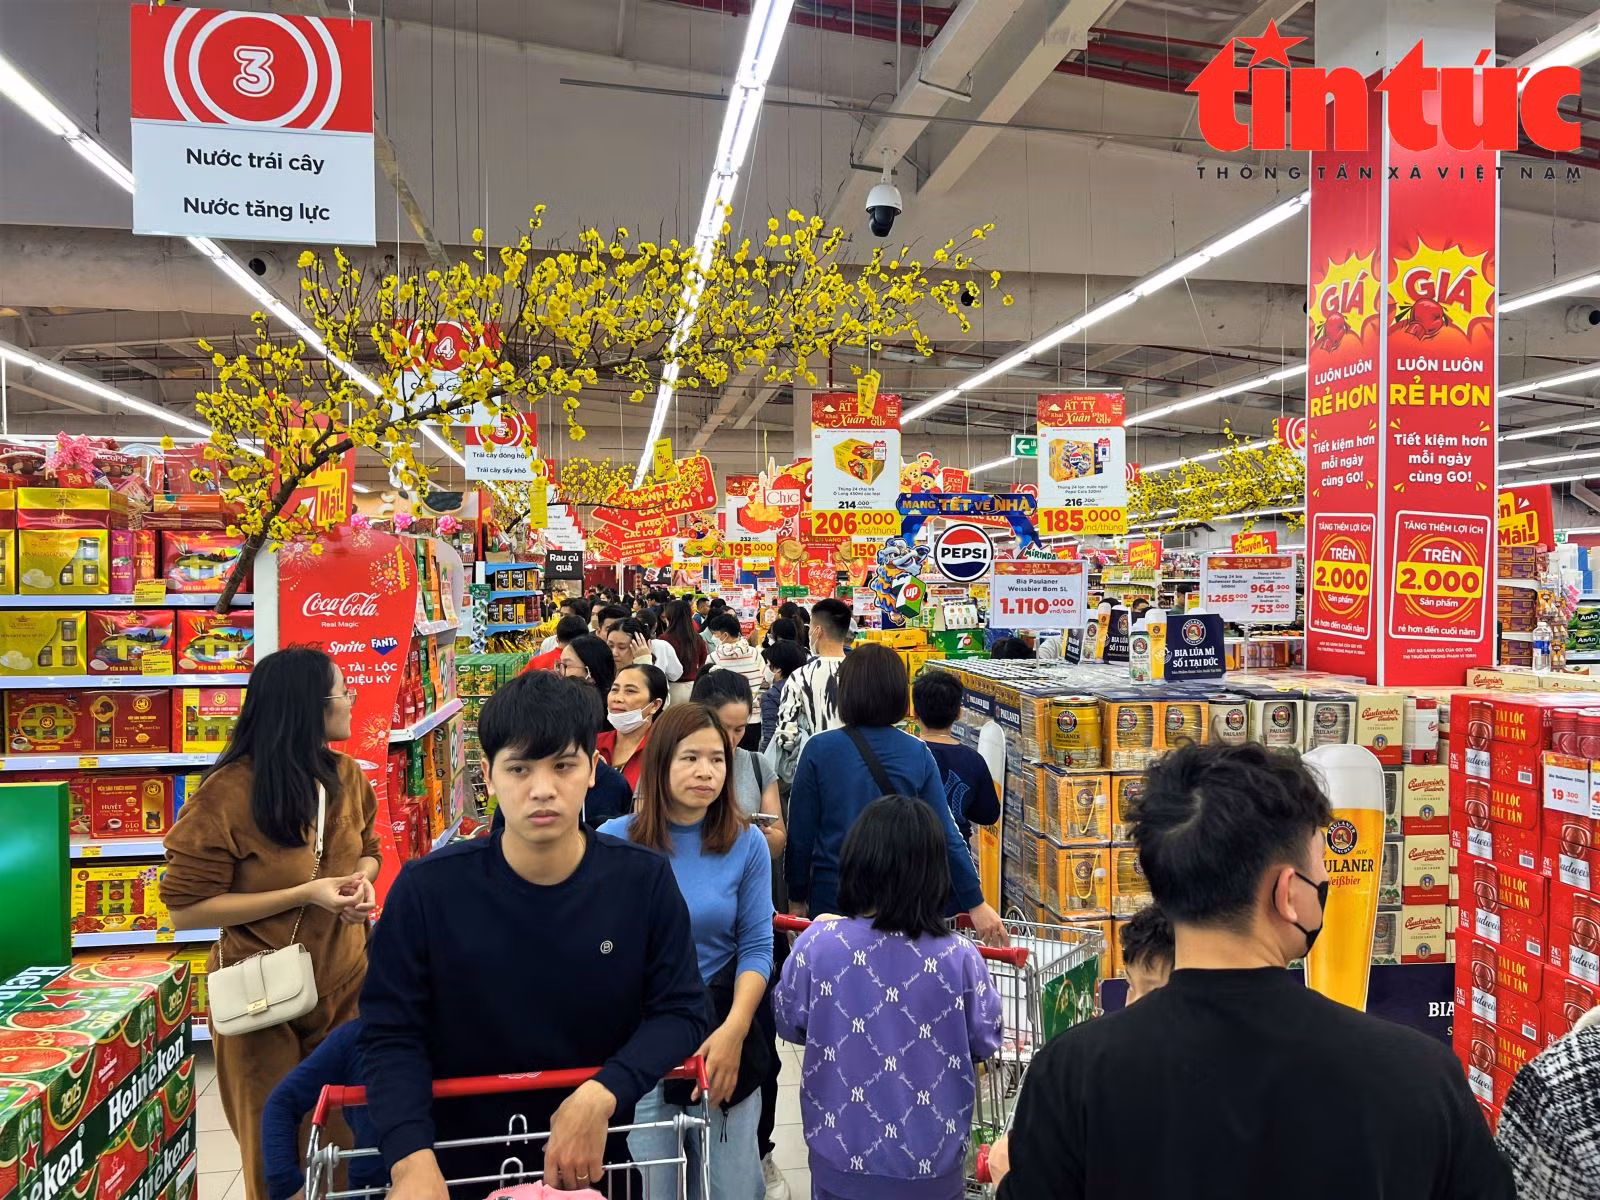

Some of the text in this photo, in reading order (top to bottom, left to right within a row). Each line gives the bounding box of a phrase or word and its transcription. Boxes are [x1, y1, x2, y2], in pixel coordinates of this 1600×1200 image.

[233, 45, 275, 97] 3
[186, 147, 325, 175] Nước trái cây
[183, 197, 330, 224] Nước tăng lực
[1320, 268, 1369, 317] GIÁ
[1404, 265, 1478, 314] GIÁ
[434, 336, 456, 361] 4
[1314, 359, 1373, 386] LUÔN LUÔN
[1396, 356, 1484, 373] LUÔN LUÔN
[1389, 375, 1490, 407] RẺ HƠN
[1310, 382, 1377, 419] RẺ HƠN
[1312, 434, 1375, 455] Tiết kiệm hơn
[1394, 431, 1488, 448] Tiết kiệm hơn
[1321, 453, 1363, 470] mỗi ngày
[1408, 448, 1472, 467] mỗi ngày
[1321, 471, 1364, 488] cùng GO!
[1409, 471, 1472, 485] cùng GO!
[665, 498, 693, 512] LOẠI
[902, 496, 1031, 512] MANG TẾT VỀ NHÀ
[1404, 520, 1484, 534] TĂNG THÊM LỢI ÍCH
[550, 552, 579, 562] Rau củ
[941, 547, 987, 559] PEPSI
[1330, 544, 1357, 561] TRÊN
[1423, 548, 1462, 563] TRÊN
[555, 562, 573, 573] quả
[1315, 566, 1368, 591] 2.000
[1399, 568, 1480, 593] 2.000
[302, 592, 379, 617] Coca-Cola
[1419, 597, 1459, 609] Sản phẩm
[340, 621, 360, 629] Magic
[1424, 625, 1439, 635] đến
[1441, 625, 1457, 636] cuối
[1459, 628, 1476, 636] năm
[327, 636, 398, 655] Sprite FANTA
[1174, 645, 1215, 658] BIA LÚA MÌ
[347, 661, 398, 673] TÀI LỘC
[1172, 656, 1219, 669] SỐ 1 TẠI ĐỨC
[346, 674, 374, 686] DIỆU
[1323, 858, 1374, 873] ULANER
[108, 1035, 185, 1136] Heineken
